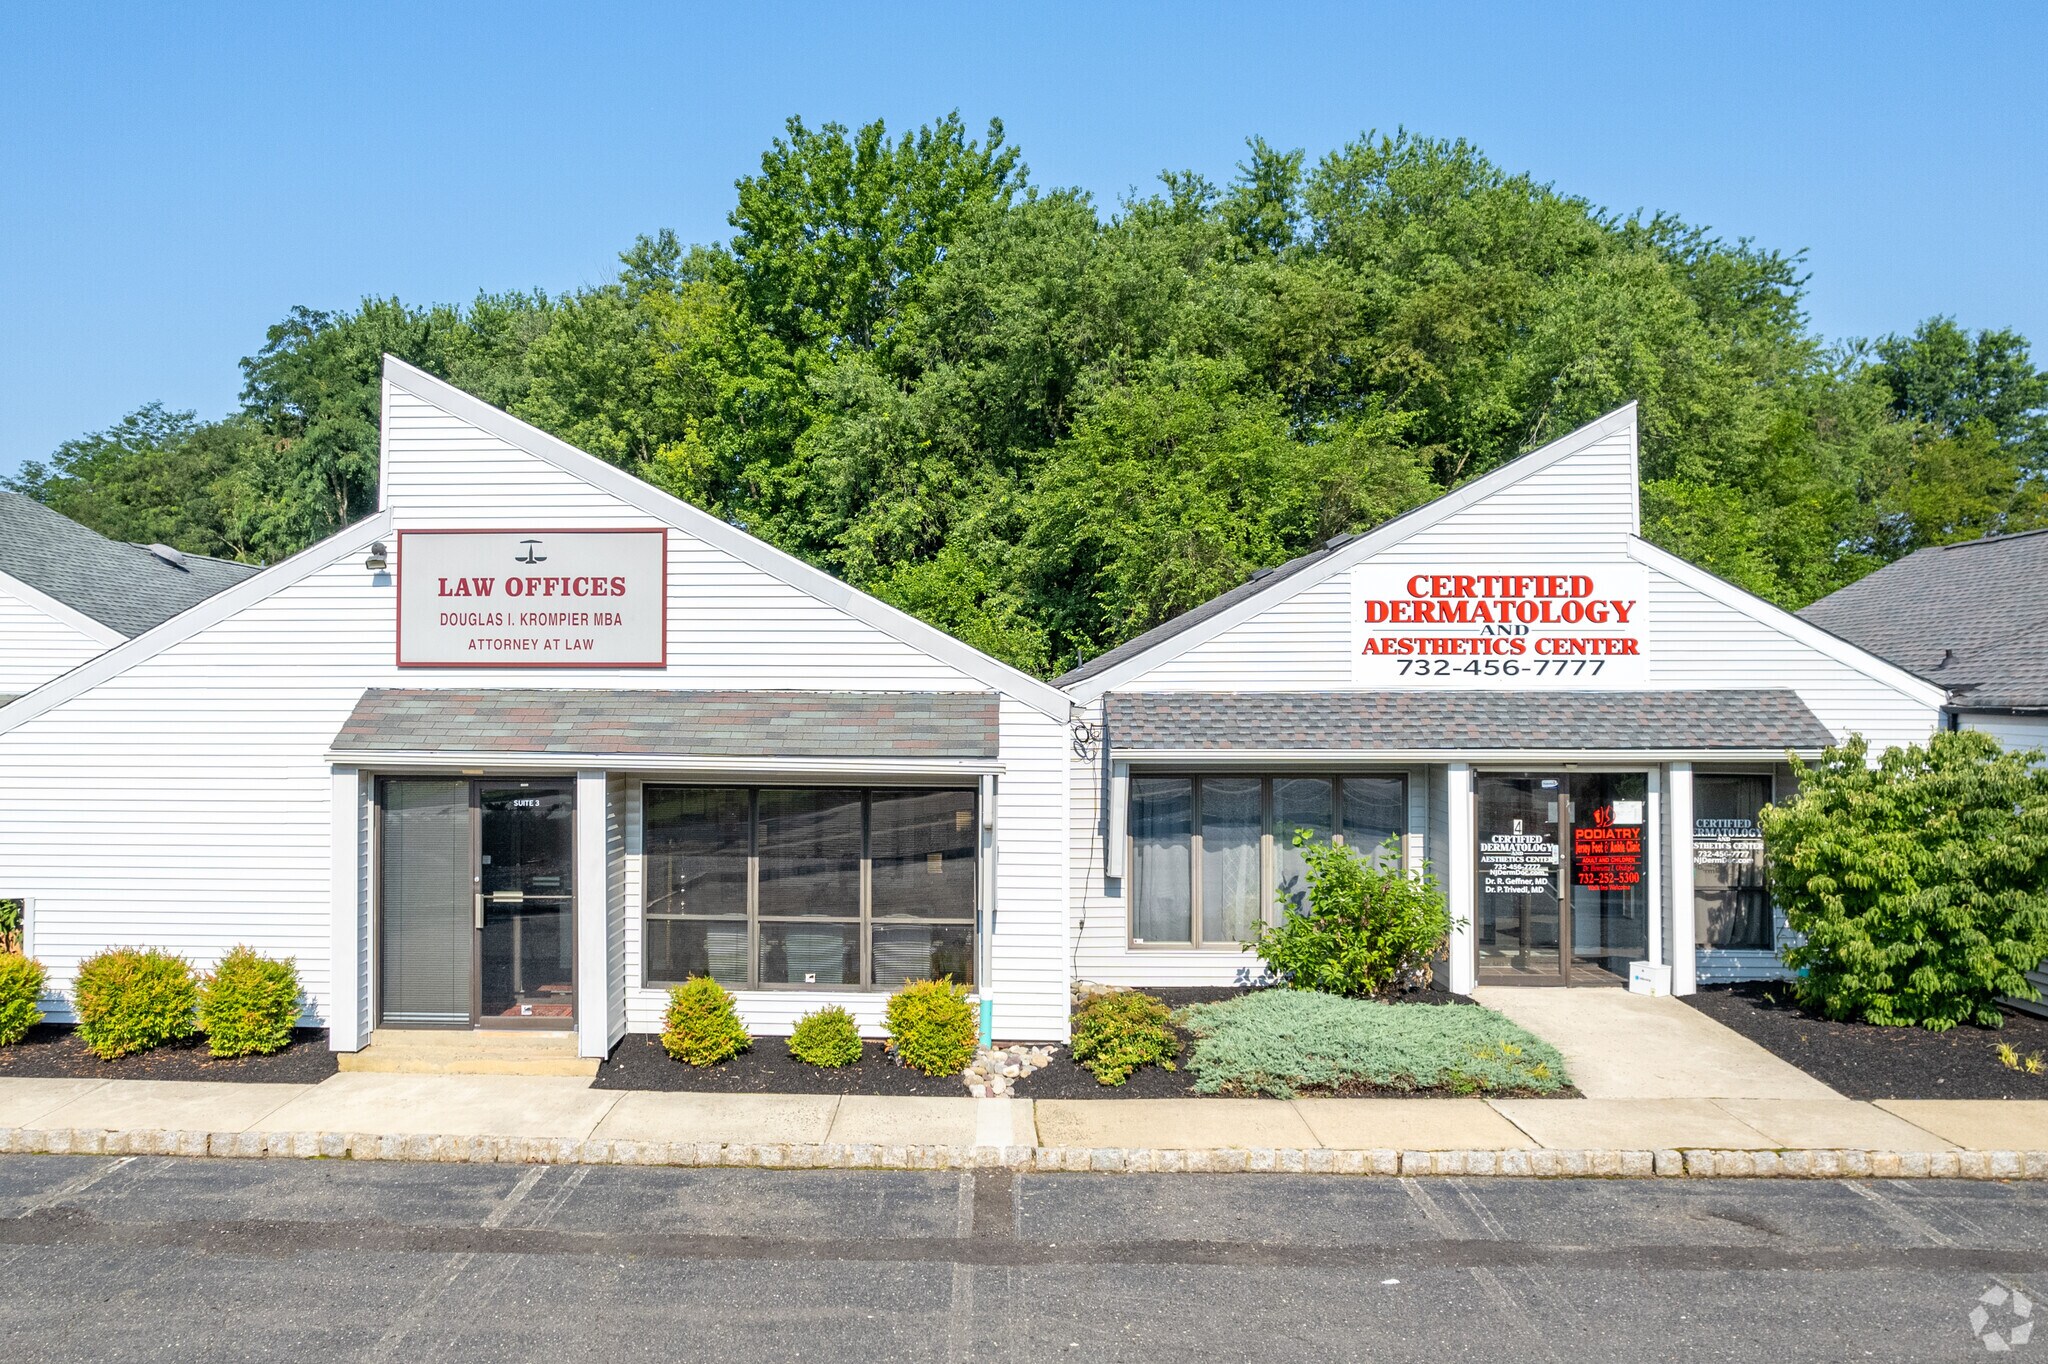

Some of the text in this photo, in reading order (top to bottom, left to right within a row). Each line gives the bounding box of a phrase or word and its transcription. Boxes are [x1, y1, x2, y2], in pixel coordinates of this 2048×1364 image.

[438, 576, 626, 597] LAW OFFICES
[1406, 575, 1594, 598] CERTIFIED
[1364, 600, 1636, 624] DERMATOLOGY
[440, 612, 622, 626] DOUGLAS I. KROMPIER MBA
[1480, 624, 1529, 636] AND
[468, 639, 594, 650] ATTORNEY AT LAW
[1362, 638, 1640, 656] AESTHETICS CENTER
[1396, 660, 1606, 676] 732-456-7777
[1514, 821, 1522, 833] 4
[1696, 819, 1751, 828] CERTIFIED
[1576, 828, 1640, 839] PODIATRY
[1693, 828, 1762, 837] ERMATOLOGY
[1492, 835, 1542, 843] CERTIFIED
[1480, 844, 1554, 852] DERMATOLOGY
[1592, 841, 1603, 853] Foot
[1578, 872, 1639, 883] 732-252-5300
